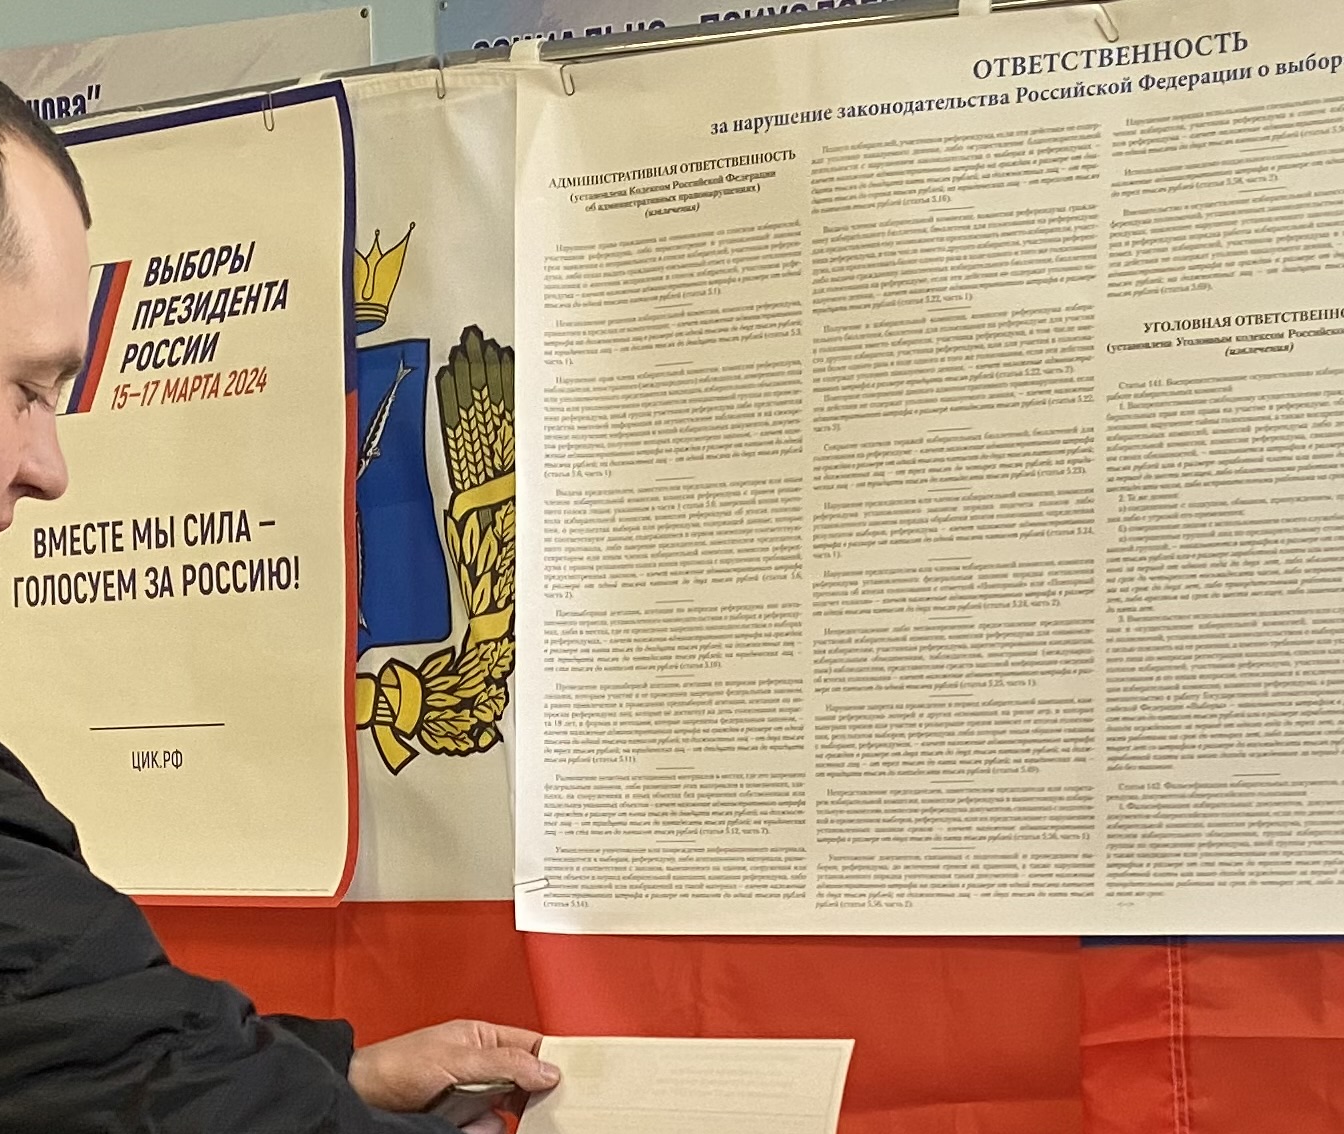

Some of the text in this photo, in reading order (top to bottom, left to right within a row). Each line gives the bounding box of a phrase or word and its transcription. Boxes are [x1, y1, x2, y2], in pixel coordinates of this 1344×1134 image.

[973, 31, 1249, 80] ОТВЕТСТВЕННОСТЬ
[710, 122, 729, 136] за
[733, 108, 833, 134] нарушение
[837, 91, 1010, 118] законодательства
[1016, 78, 1133, 104] Российской
[1138, 66, 1253, 93] Федерации
[1258, 64, 1270, 78] о
[548, 150, 796, 189] АДМИНИСТРАТИВНАЯ ОТВЕТСТВЕННОСТЬ
[143, 241, 256, 287] ВЫБОРЫ
[132, 278, 290, 331] ПРЕЗИДЕНТА
[1143, 316, 1232, 334] УГОЛОВНАЯ
[120, 331, 222, 374] РОССИИ
[162, 371, 222, 406] МАРТА
[224, 366, 268, 399] 2024
[33, 520, 124, 559] ВМЕСТЕ
[132, 516, 175, 550] МЫ
[184, 509, 252, 547] СИЛА
[13, 556, 301, 608] ГОЛОСУЕМ ЗА РОССИЮ!
[131, 748, 184, 772] ЦИК.РФ
